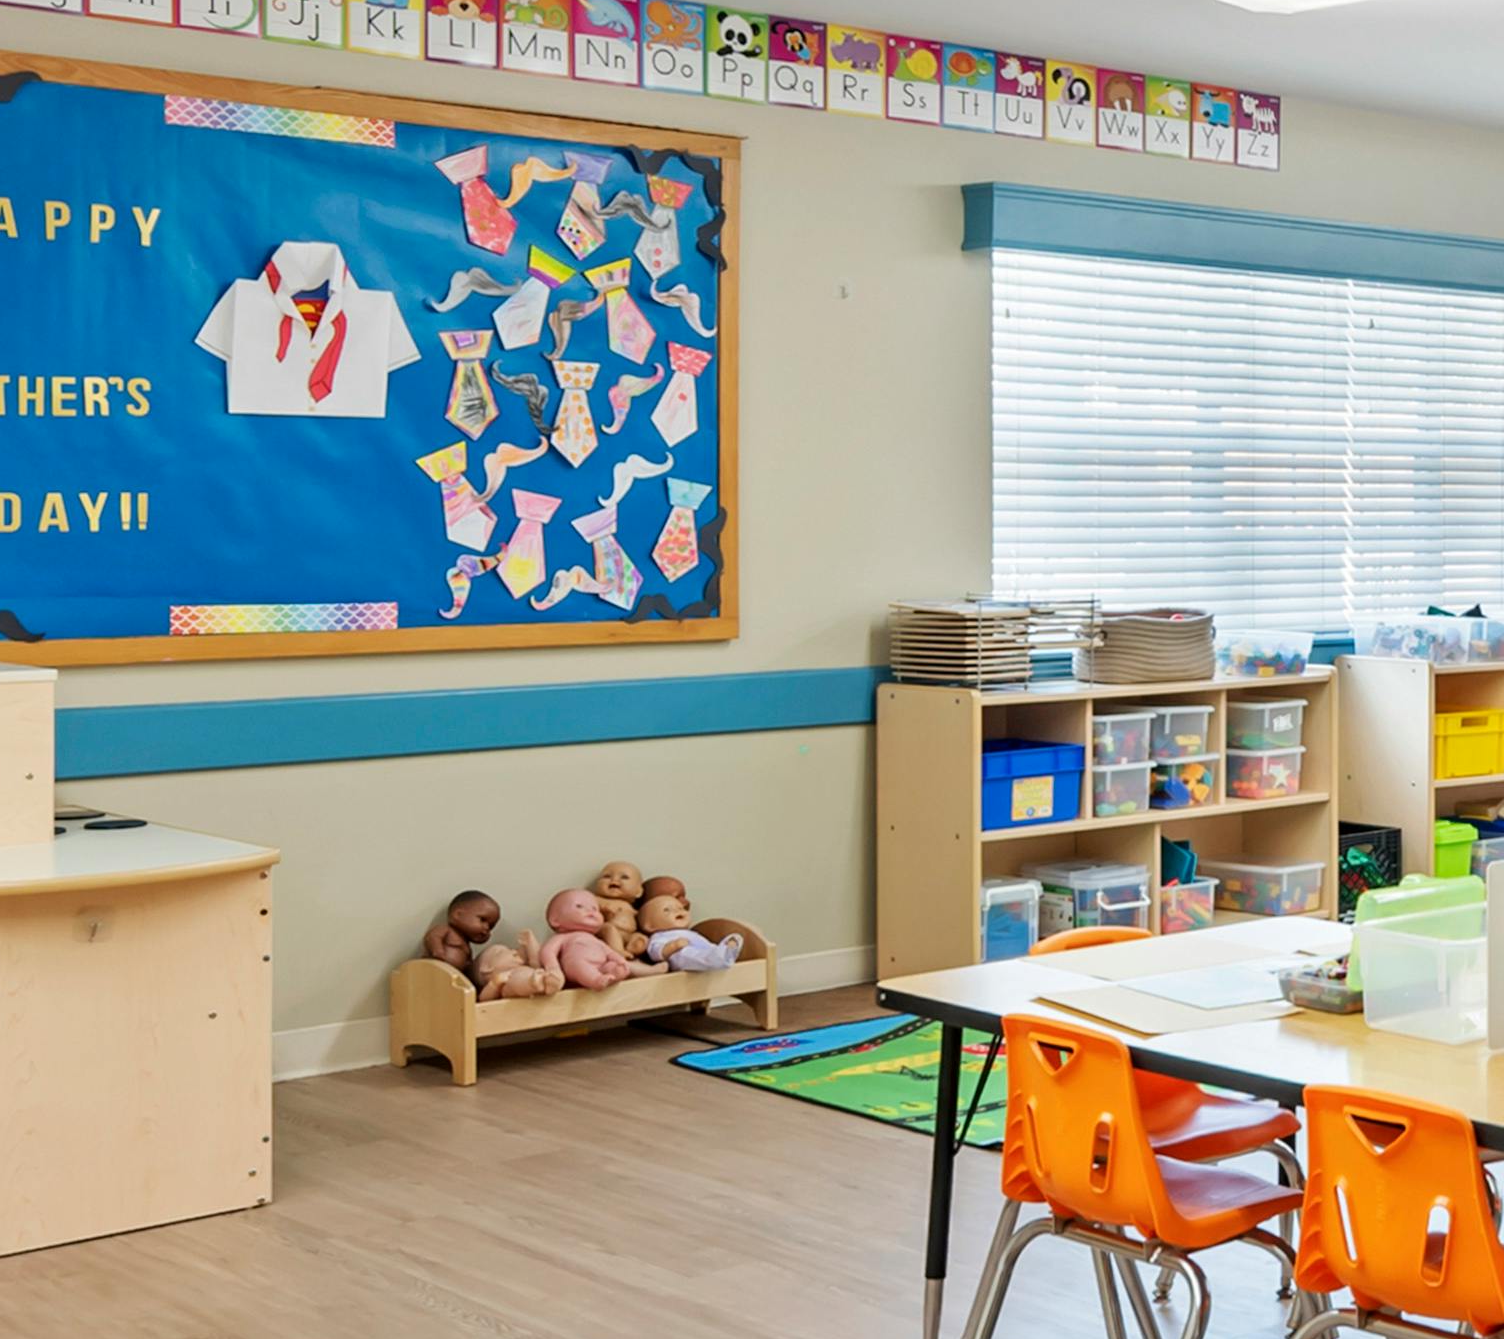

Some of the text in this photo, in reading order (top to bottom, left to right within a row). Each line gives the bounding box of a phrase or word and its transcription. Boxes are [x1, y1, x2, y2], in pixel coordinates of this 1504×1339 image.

[366, 6, 405, 41] Kk
[448, 18, 476, 49] Ll
[508, 28, 563, 62] Mm
[585, 37, 627, 70] Nn
[652, 48, 694, 79] Oo
[721, 56, 754, 98] Pp
[773, 64, 818, 107] Qq
[841, 73, 869, 102] Rr
[902, 82, 928, 110] Ss
[956, 89, 980, 116] Tt
[1004, 97, 1034, 125] Uu
[1056, 105, 1086, 132] Vv
[1101, 110, 1140, 139] Ww
[1153, 119, 1181, 146] Xx
[1200, 125, 1226, 160] Yy
[1246, 133, 1270, 158] Zz
